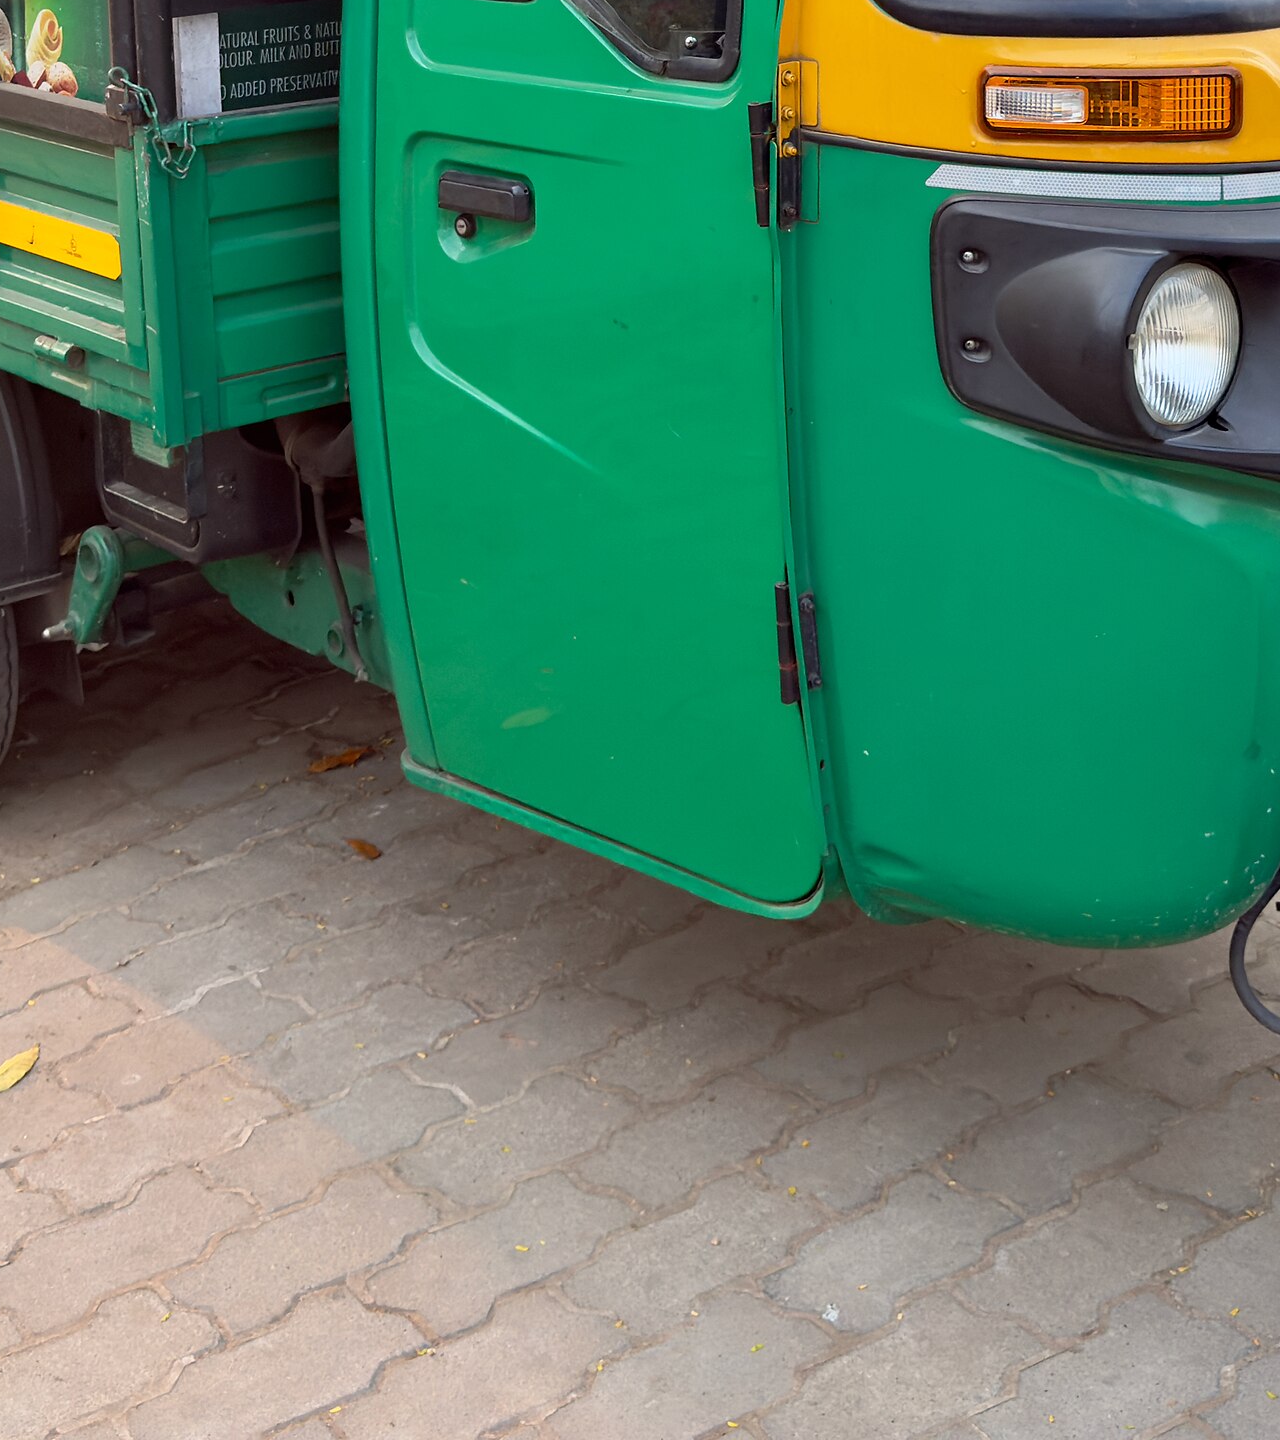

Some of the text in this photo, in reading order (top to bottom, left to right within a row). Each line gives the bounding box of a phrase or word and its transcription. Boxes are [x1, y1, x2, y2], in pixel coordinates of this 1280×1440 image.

[263, 25, 301, 44] FRUITS
[304, 24, 312, 39] &
[260, 46, 285, 65] MILK
[288, 44, 311, 61] AND
[230, 80, 267, 100] ADDED
